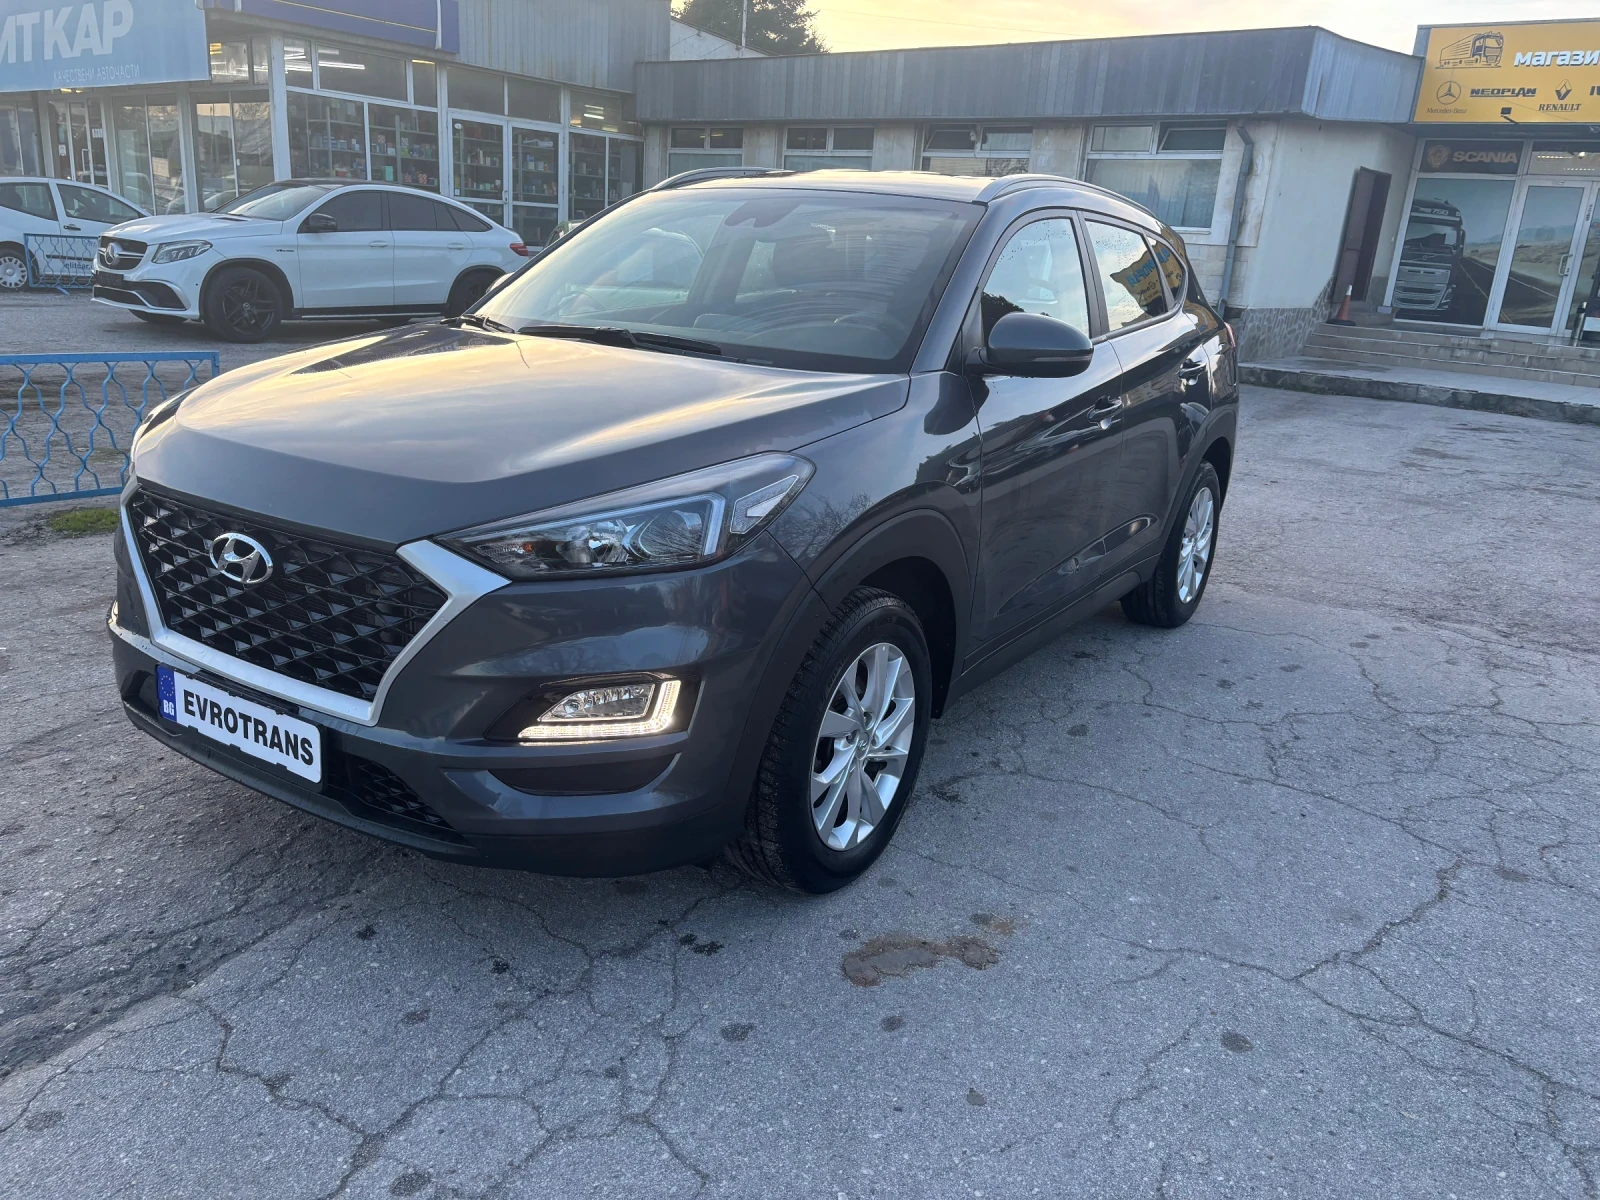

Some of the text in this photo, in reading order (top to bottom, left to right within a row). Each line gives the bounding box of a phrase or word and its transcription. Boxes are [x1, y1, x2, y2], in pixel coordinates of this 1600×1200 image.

[53, 64, 140, 83] КАЧЕСТВЕНИ АВТОЧАСТИ
[1470, 87, 1537, 97] NEOPLAN
[1538, 103, 1582, 112] RENAULT
[1452, 150, 1518, 164] SCANIA
[163, 700, 175, 717] BG
[183, 689, 314, 766] EVROTRANS
